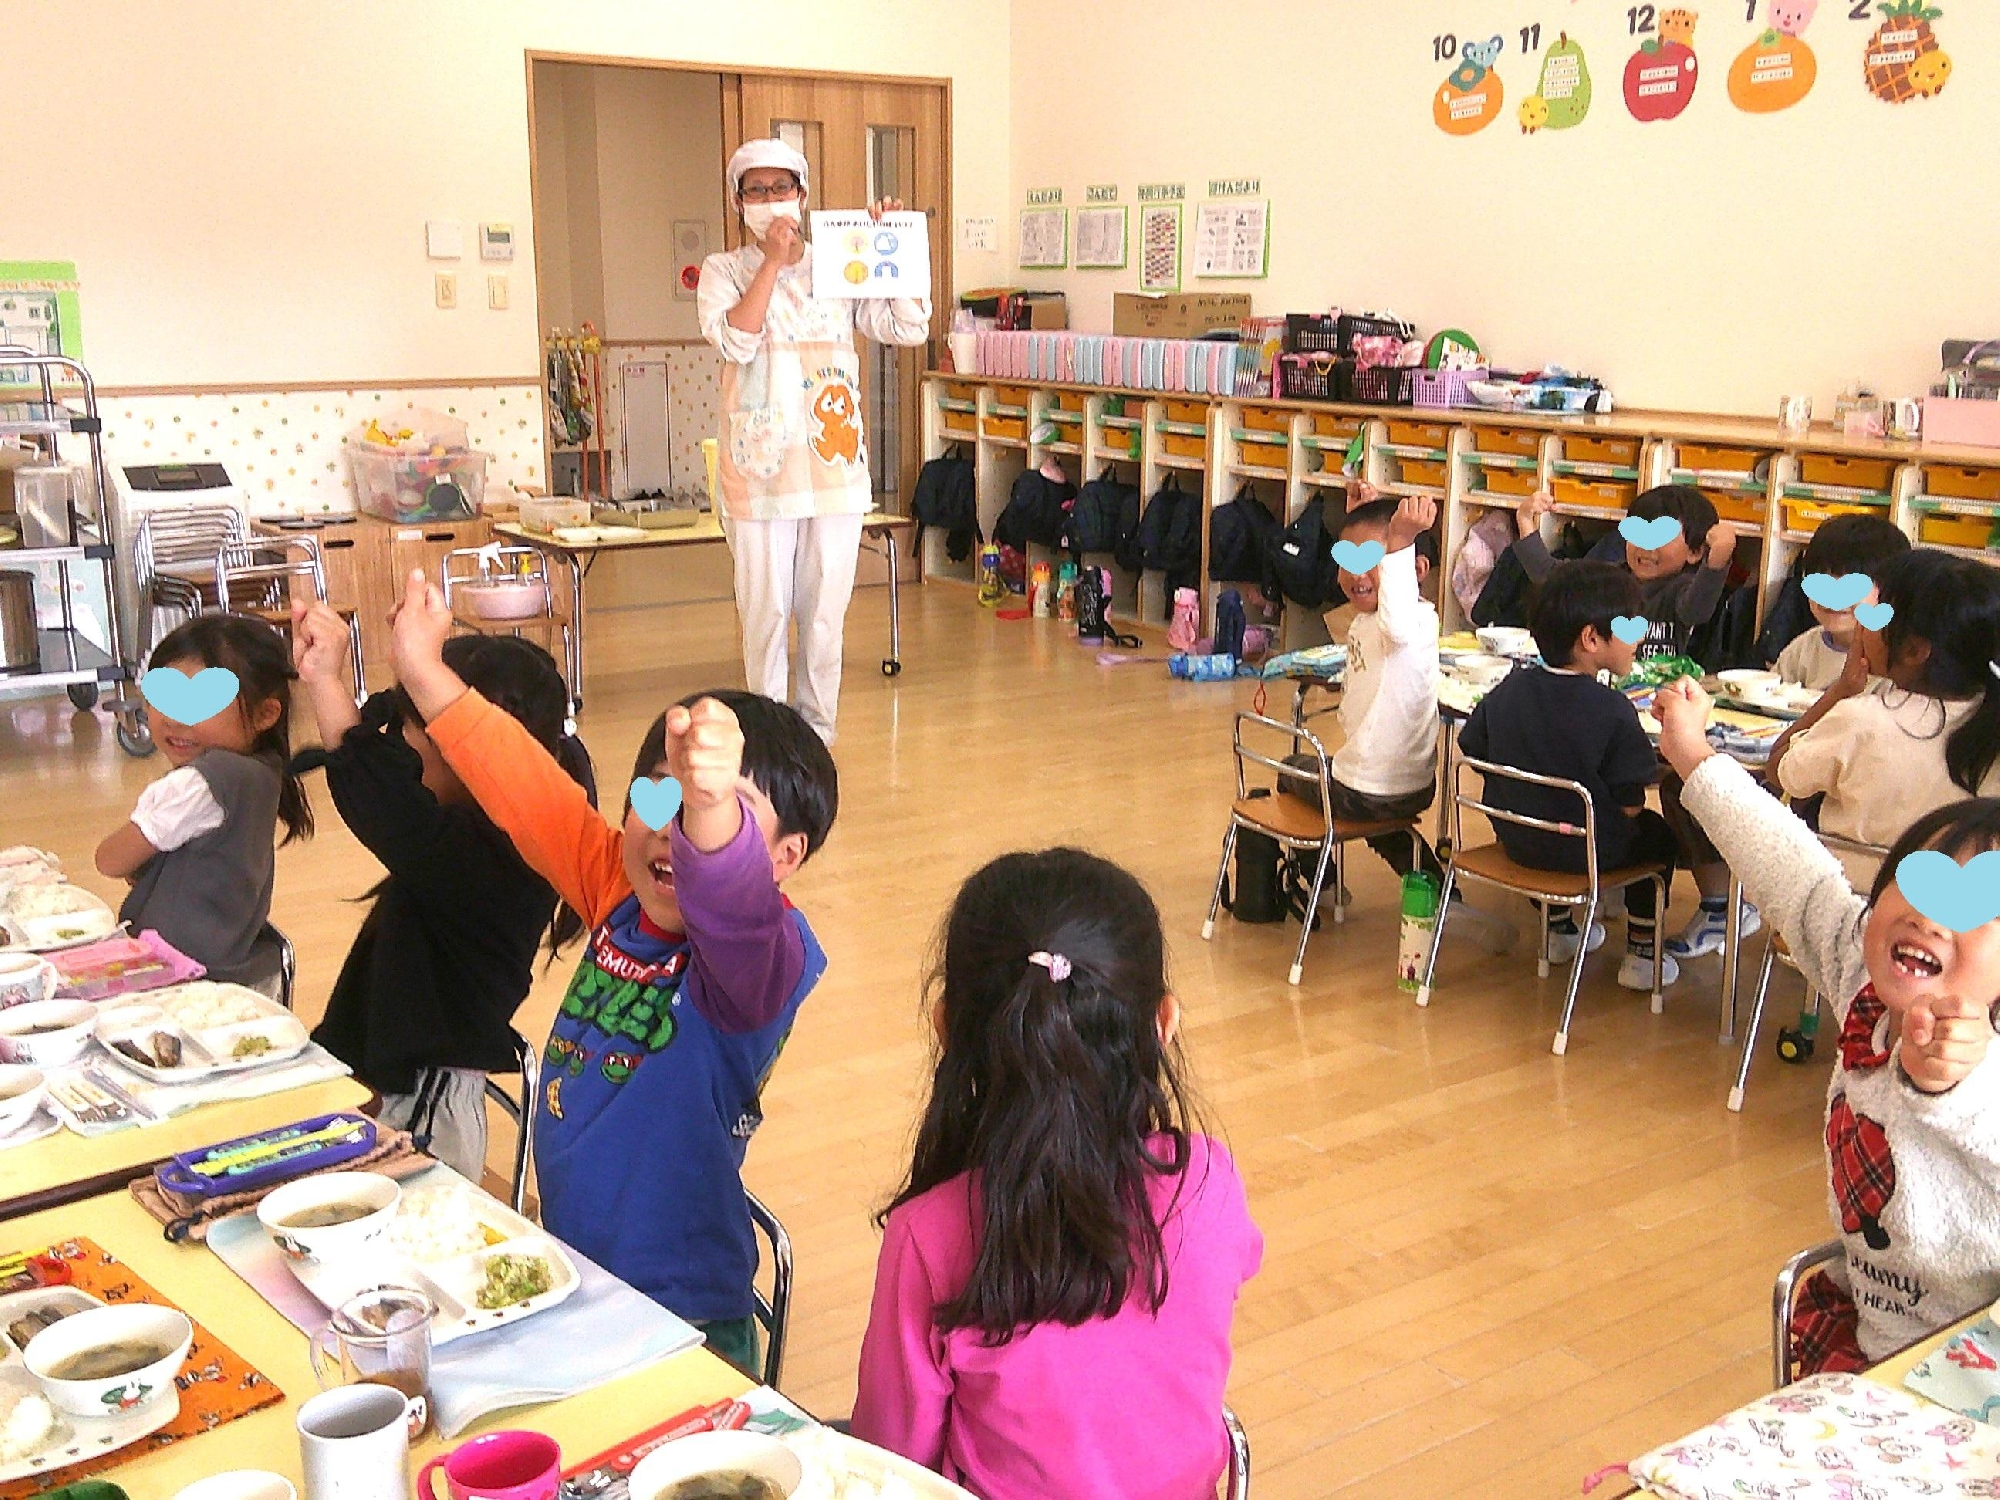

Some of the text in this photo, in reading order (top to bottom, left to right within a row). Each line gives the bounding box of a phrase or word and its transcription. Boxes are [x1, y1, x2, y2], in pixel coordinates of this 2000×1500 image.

[1627, 5, 1656, 36] 12
[1848, 0, 1871, 19] 2
[1432, 34, 1456, 61] 10
[1519, 22, 1541, 54] 11
